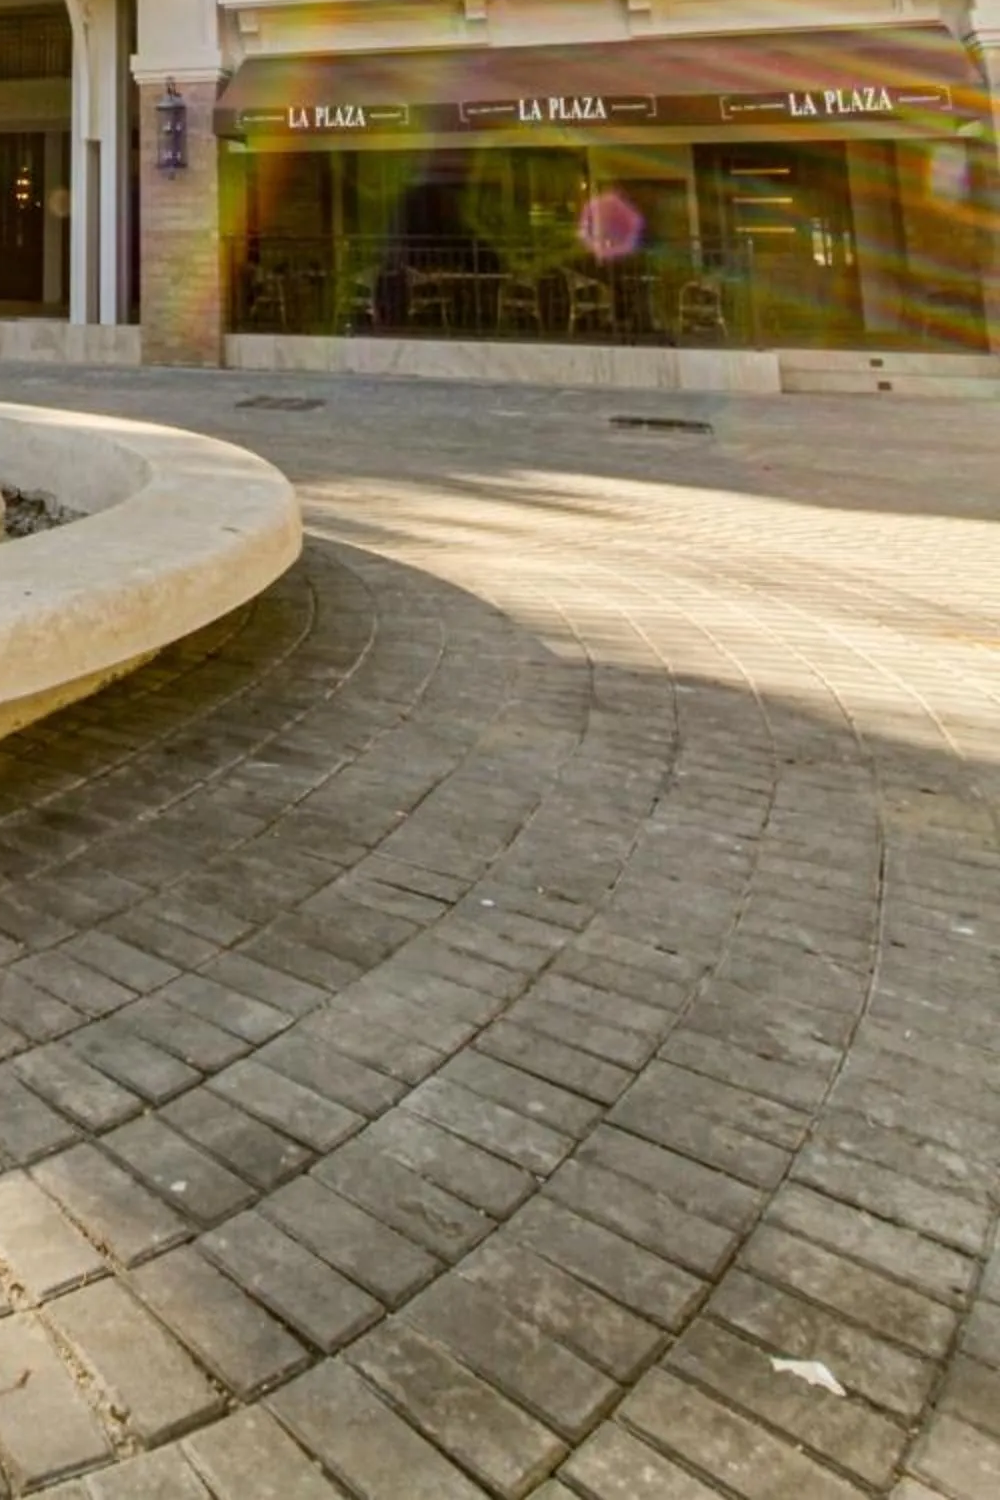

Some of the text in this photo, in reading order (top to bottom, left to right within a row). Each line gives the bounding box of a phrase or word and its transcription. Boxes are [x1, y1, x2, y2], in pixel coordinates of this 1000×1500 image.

[519, 99, 543, 121] LA
[549, 97, 607, 121] PLAZA
[787, 87, 894, 117] LA PLAZA
[288, 105, 366, 128] LA PLAZA
